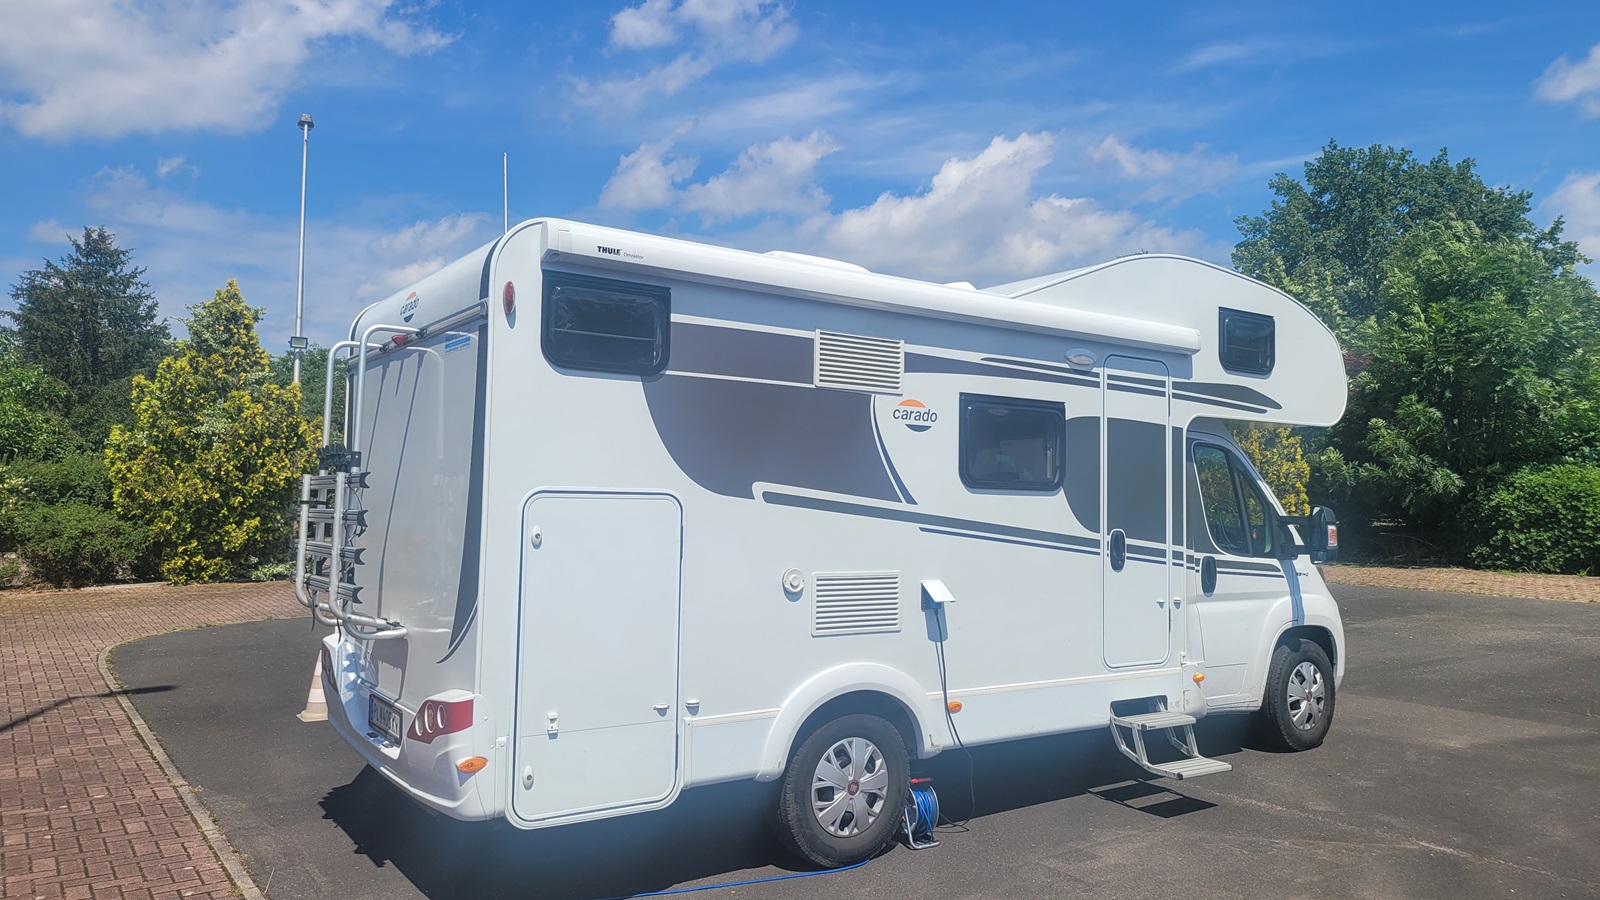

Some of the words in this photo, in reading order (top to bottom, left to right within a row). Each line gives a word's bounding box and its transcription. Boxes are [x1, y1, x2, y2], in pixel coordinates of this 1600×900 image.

[597, 245, 621, 256] THULE
[400, 296, 419, 315] carado
[892, 408, 938, 423] carado
